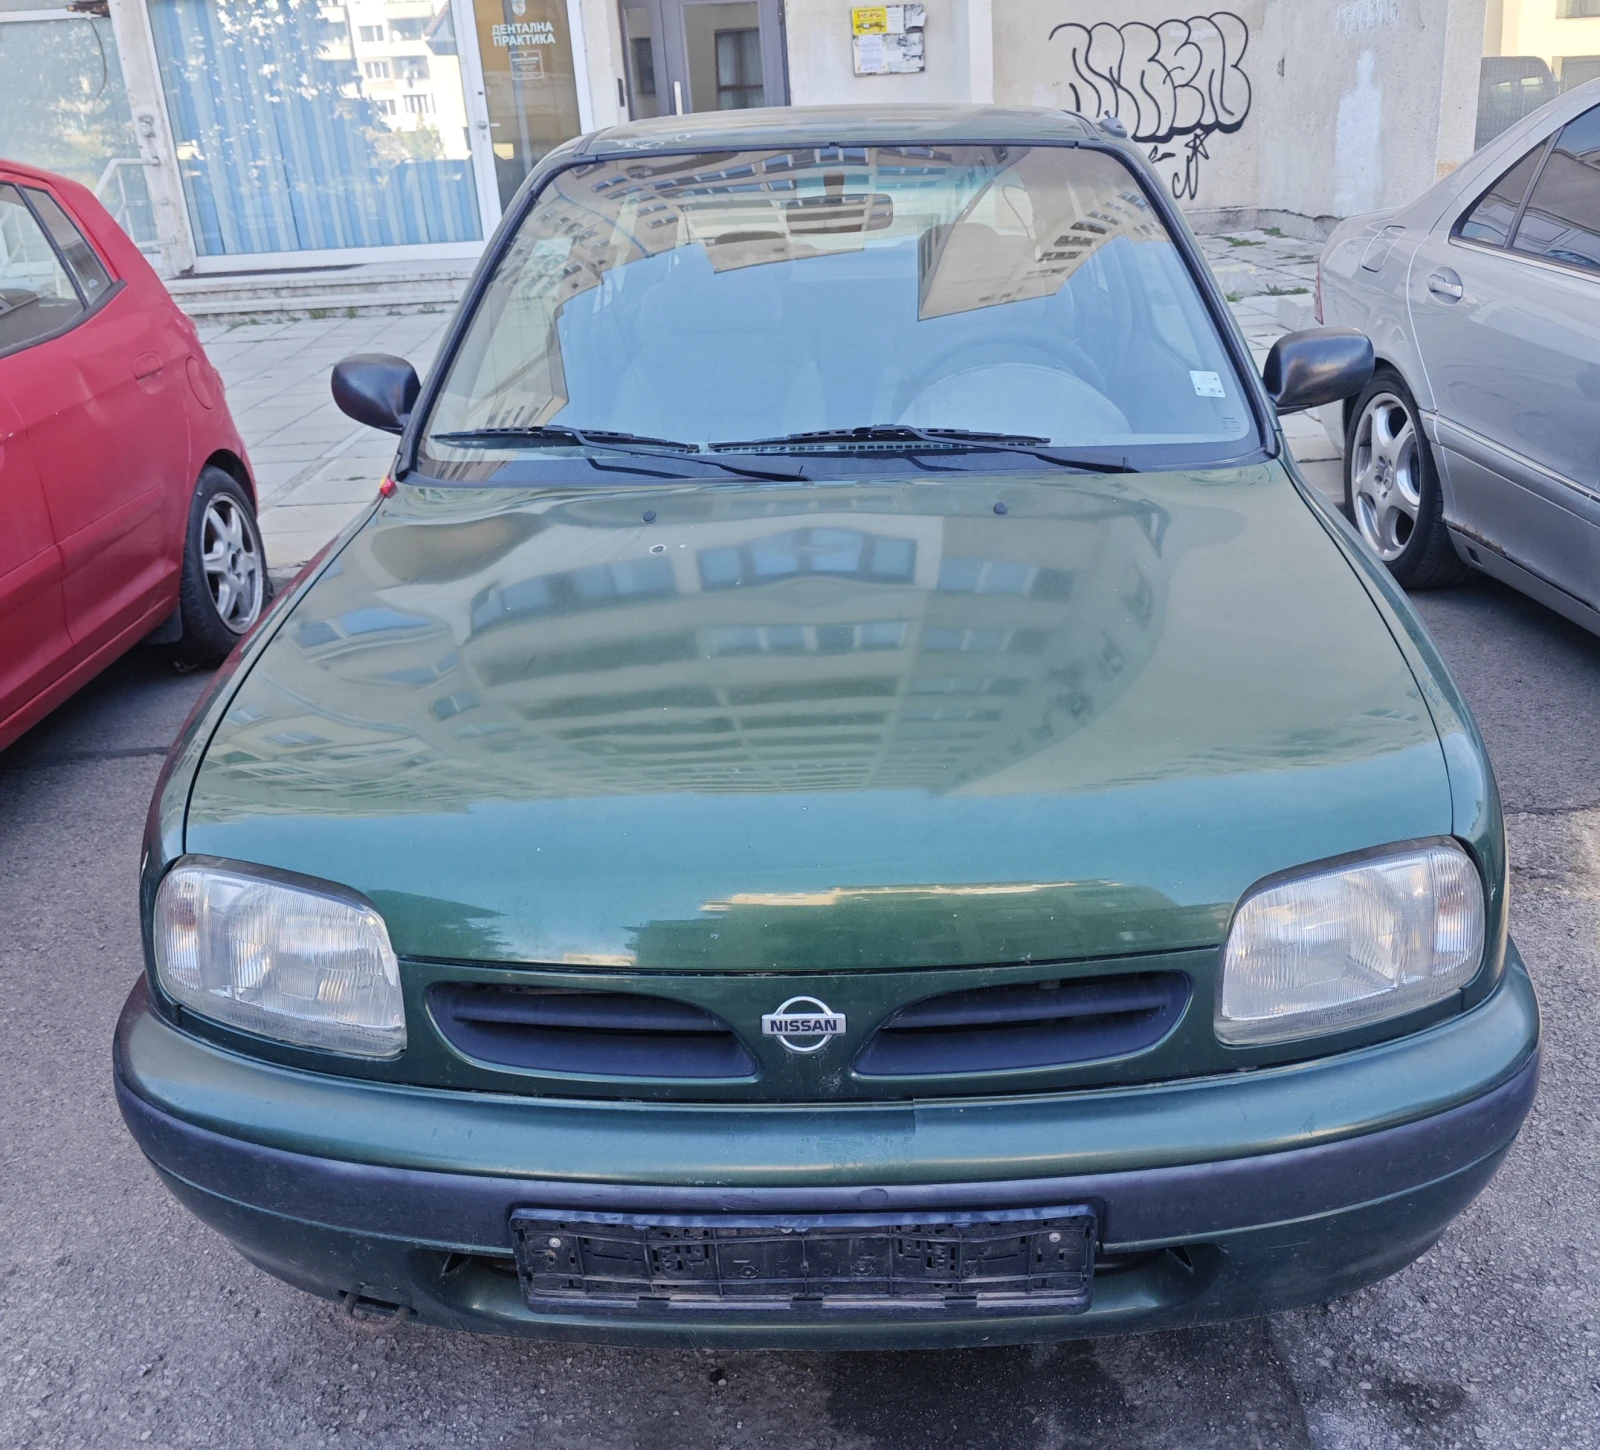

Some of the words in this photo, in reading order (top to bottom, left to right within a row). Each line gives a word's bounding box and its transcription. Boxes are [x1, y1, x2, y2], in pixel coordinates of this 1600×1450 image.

[492, 21, 554, 36] ДЕНТАЛНА
[493, 33, 556, 47] ПРАКТИКА
[770, 1020, 837, 1032] NISSAN
